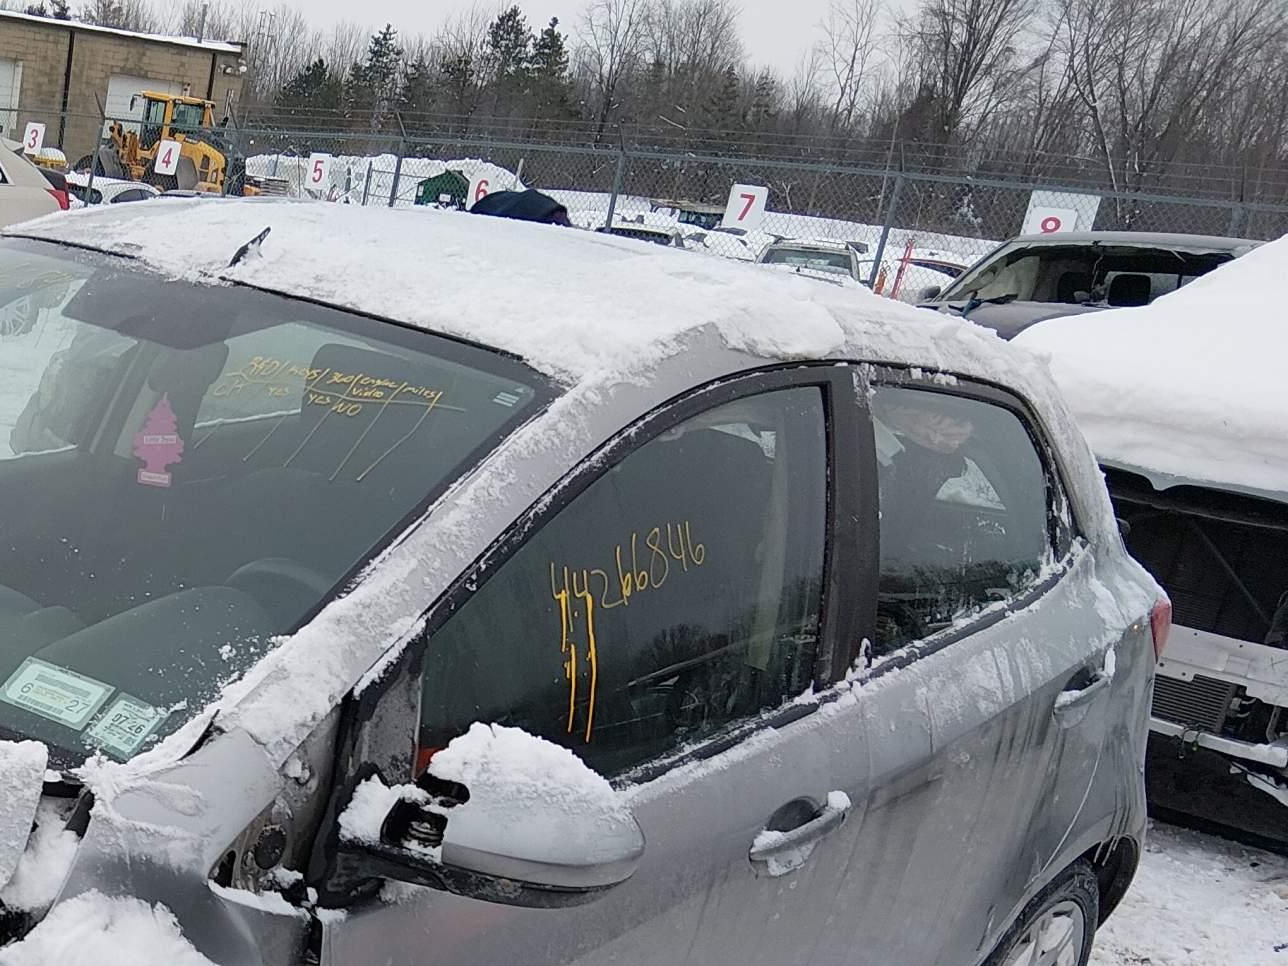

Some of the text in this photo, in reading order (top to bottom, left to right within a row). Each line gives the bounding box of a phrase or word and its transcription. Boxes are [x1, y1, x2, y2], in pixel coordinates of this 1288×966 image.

[28, 129, 39, 149] 3
[162, 147, 173, 168] 4
[312, 160, 324, 183] 5
[475, 179, 489, 202] 6
[738, 193, 756, 221] 7
[550, 520, 706, 634] 44266846
[20, 682, 34, 695] 6
[65, 699, 91, 714] 27
